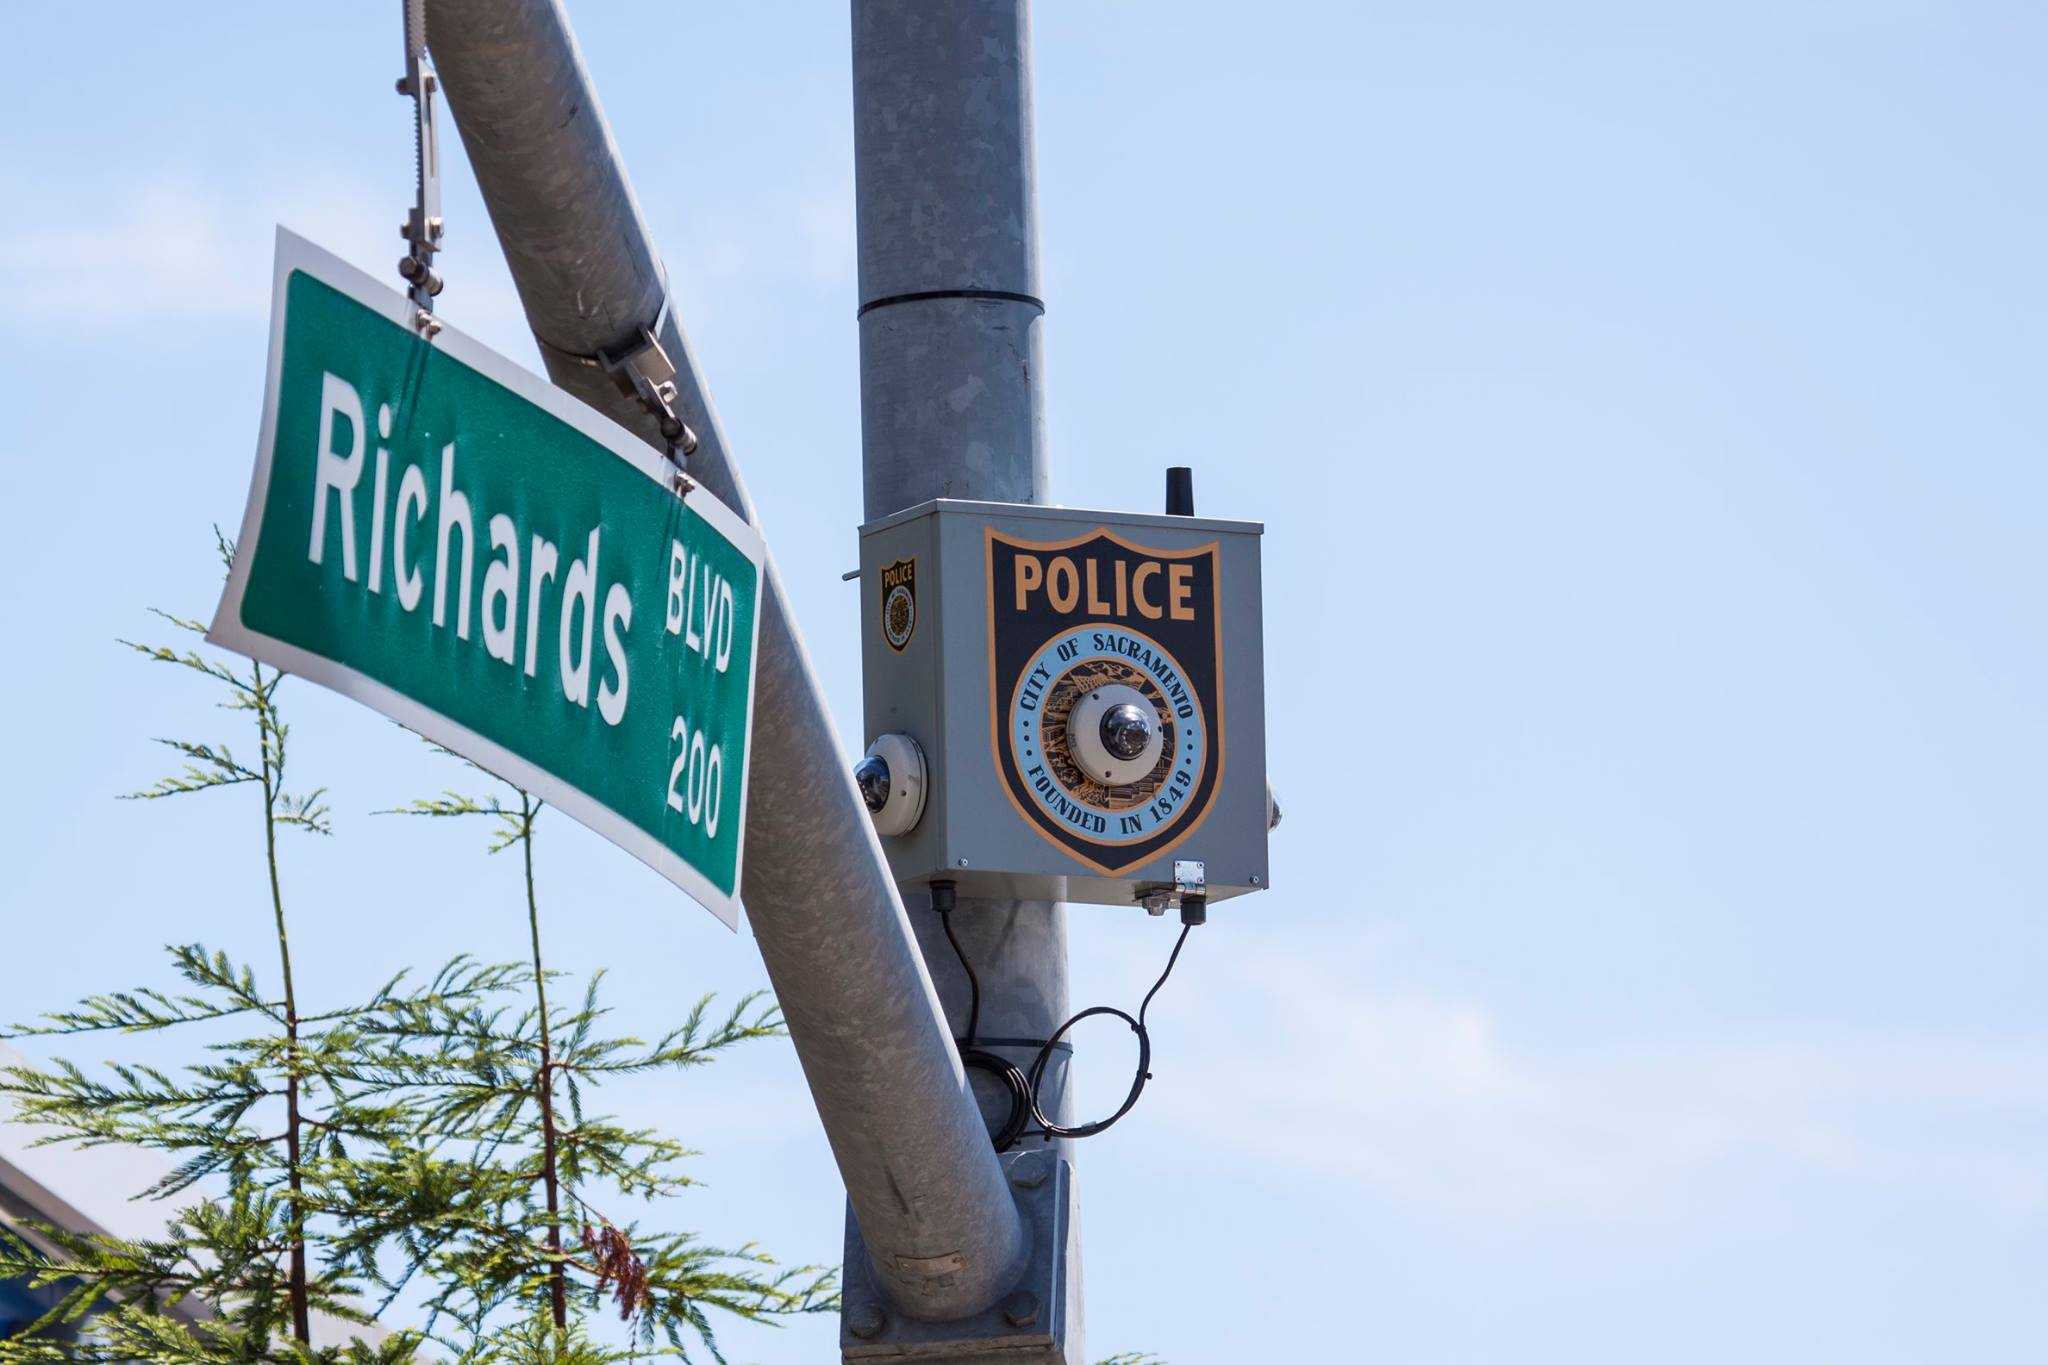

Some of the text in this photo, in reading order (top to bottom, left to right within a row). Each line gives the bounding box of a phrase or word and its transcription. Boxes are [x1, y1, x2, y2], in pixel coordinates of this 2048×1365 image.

[308, 371, 732, 726] Richards BLVD
[885, 564, 912, 588] POLICE
[1015, 554, 1195, 621] POLICE
[1020, 633, 1193, 719] CITY OF SACRAMENTO
[668, 716, 723, 838] 200
[1028, 765, 1191, 834] FOUNDED IN 1849
